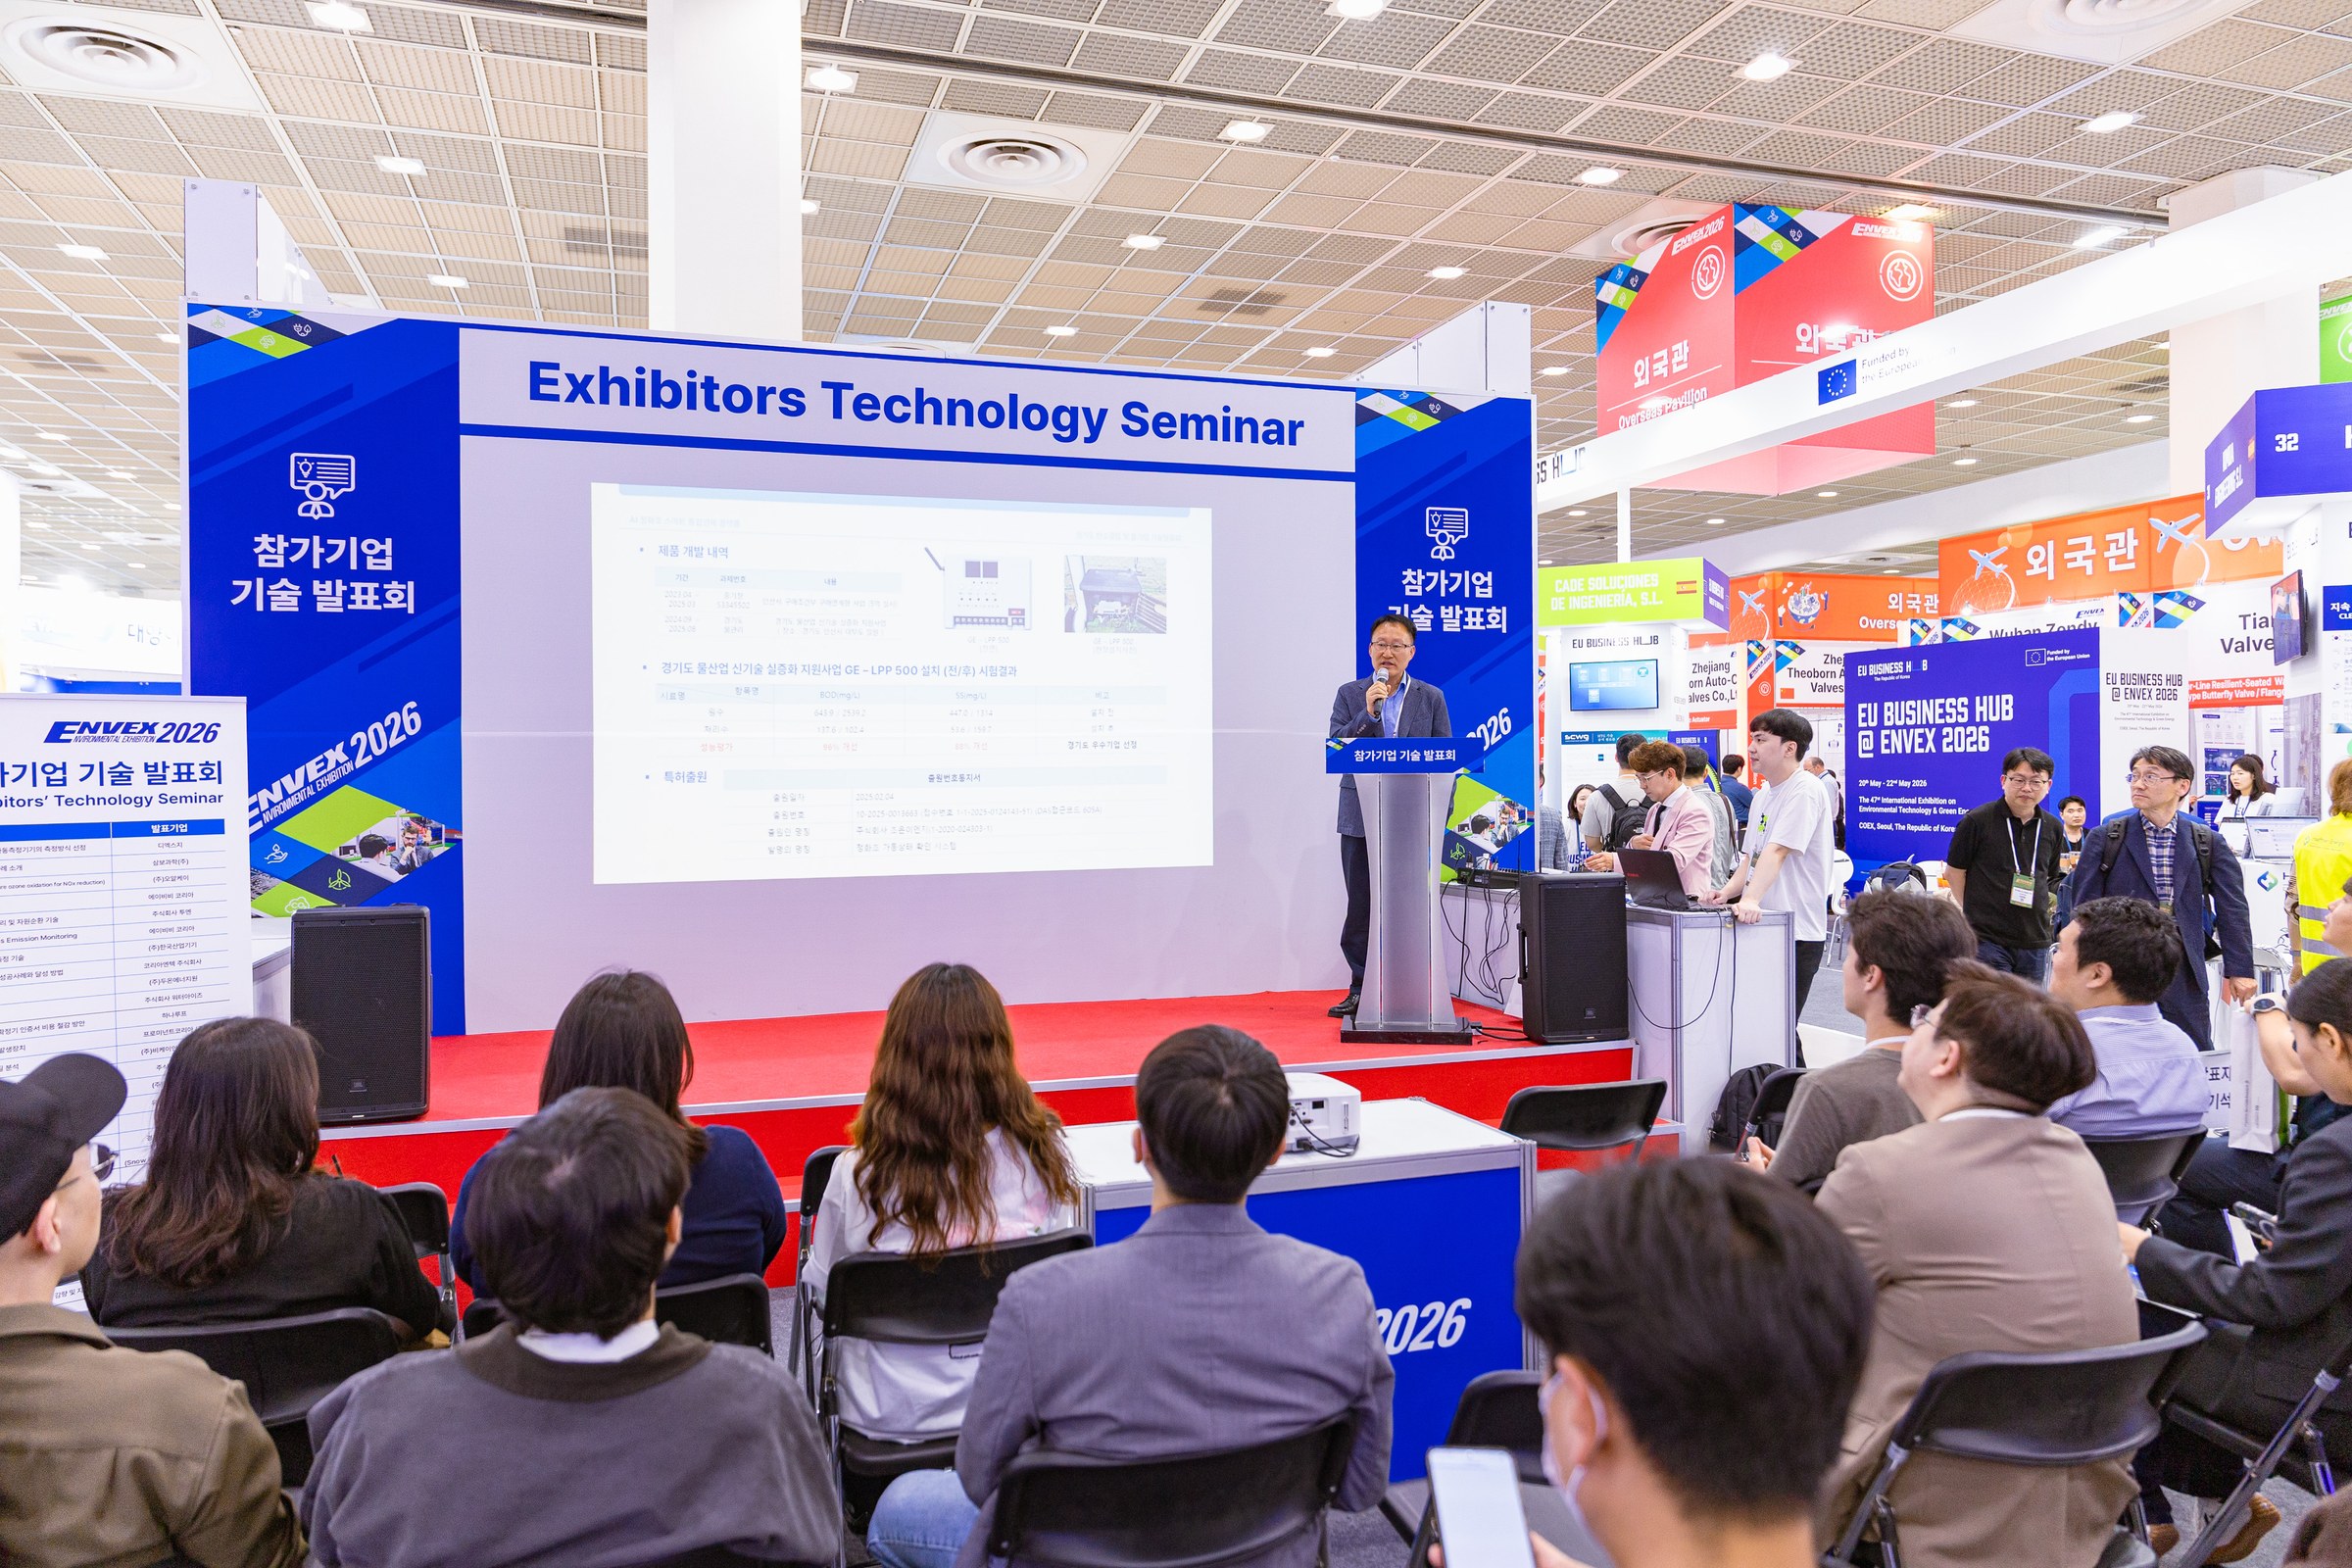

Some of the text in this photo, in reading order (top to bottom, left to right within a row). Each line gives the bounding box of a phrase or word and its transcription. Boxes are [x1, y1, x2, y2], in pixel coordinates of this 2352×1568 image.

[1704, 216, 1725, 241] 2026
[1634, 339, 1690, 390] 외국관
[529, 360, 1304, 446] Exhibitors Technology Seminar
[1619, 386, 1708, 429] Overseas Pavilion
[2275, 432, 2299, 453] 32
[252, 533, 394, 571] 참가기업
[659, 544, 729, 560] 제품 개발 내역
[2026, 526, 2138, 582] 외국관
[1400, 568, 1494, 599] 참가기업
[1554, 572, 1659, 593] CADE SOLUCIONES
[230, 577, 416, 614] 기술 발표회
[1550, 596, 1566, 612] DE
[1641, 591, 1664, 607] S.L.
[1887, 592, 1939, 614] 외국관
[1388, 604, 1507, 634] 기술 발표회
[1572, 638, 1584, 649] EU
[662, 662, 1017, 678] 경기도 물산업 신기술 실증화 지원사업 GE LPP 500 설치 (전/후) 시험결과
[1691, 661, 1731, 674] Zhejiang
[1787, 667, 1837, 679] Theoborn
[1857, 662, 1904, 677] EU BUSINESS
[1810, 682, 1844, 693] Valves
[2106, 672, 2182, 687] EU BUSINESS HUB
[2211, 678, 2272, 690] Resilient-Seated
[2111, 687, 2179, 702] @ ENVEX 2026
[2202, 689, 2233, 701] Butterfly
[2234, 689, 2255, 699] Valve
[1857, 694, 2014, 728] EU BUSINESS HUB
[43, 720, 222, 744] ENVEX 2026
[350, 700, 422, 769] 2026
[1092, 740, 1120, 751] 우수기업
[1123, 740, 1138, 750] 선정
[1858, 725, 1990, 759] @ ENVEX 2026
[1353, 748, 1456, 762] 참가기업 기술 발표회
[79, 760, 135, 787] 기술
[144, 760, 222, 786] 발표회
[316, 760, 355, 793] EXHIBITION
[664, 770, 708, 784] 특허출원
[1898, 779, 1911, 788] May
[54, 792, 224, 808] Technology Seminar
[1882, 796, 1917, 805] International
[1898, 806, 1932, 815] Technology
[1938, 807, 1956, 815] Green
[151, 823, 188, 834] 발표기업
[1858, 821, 1876, 831] COEX,
[1876, 822, 1894, 831] Seoul,
[1906, 823, 1932, 833] Republic
[1374, 1297, 1473, 1356] 2026
